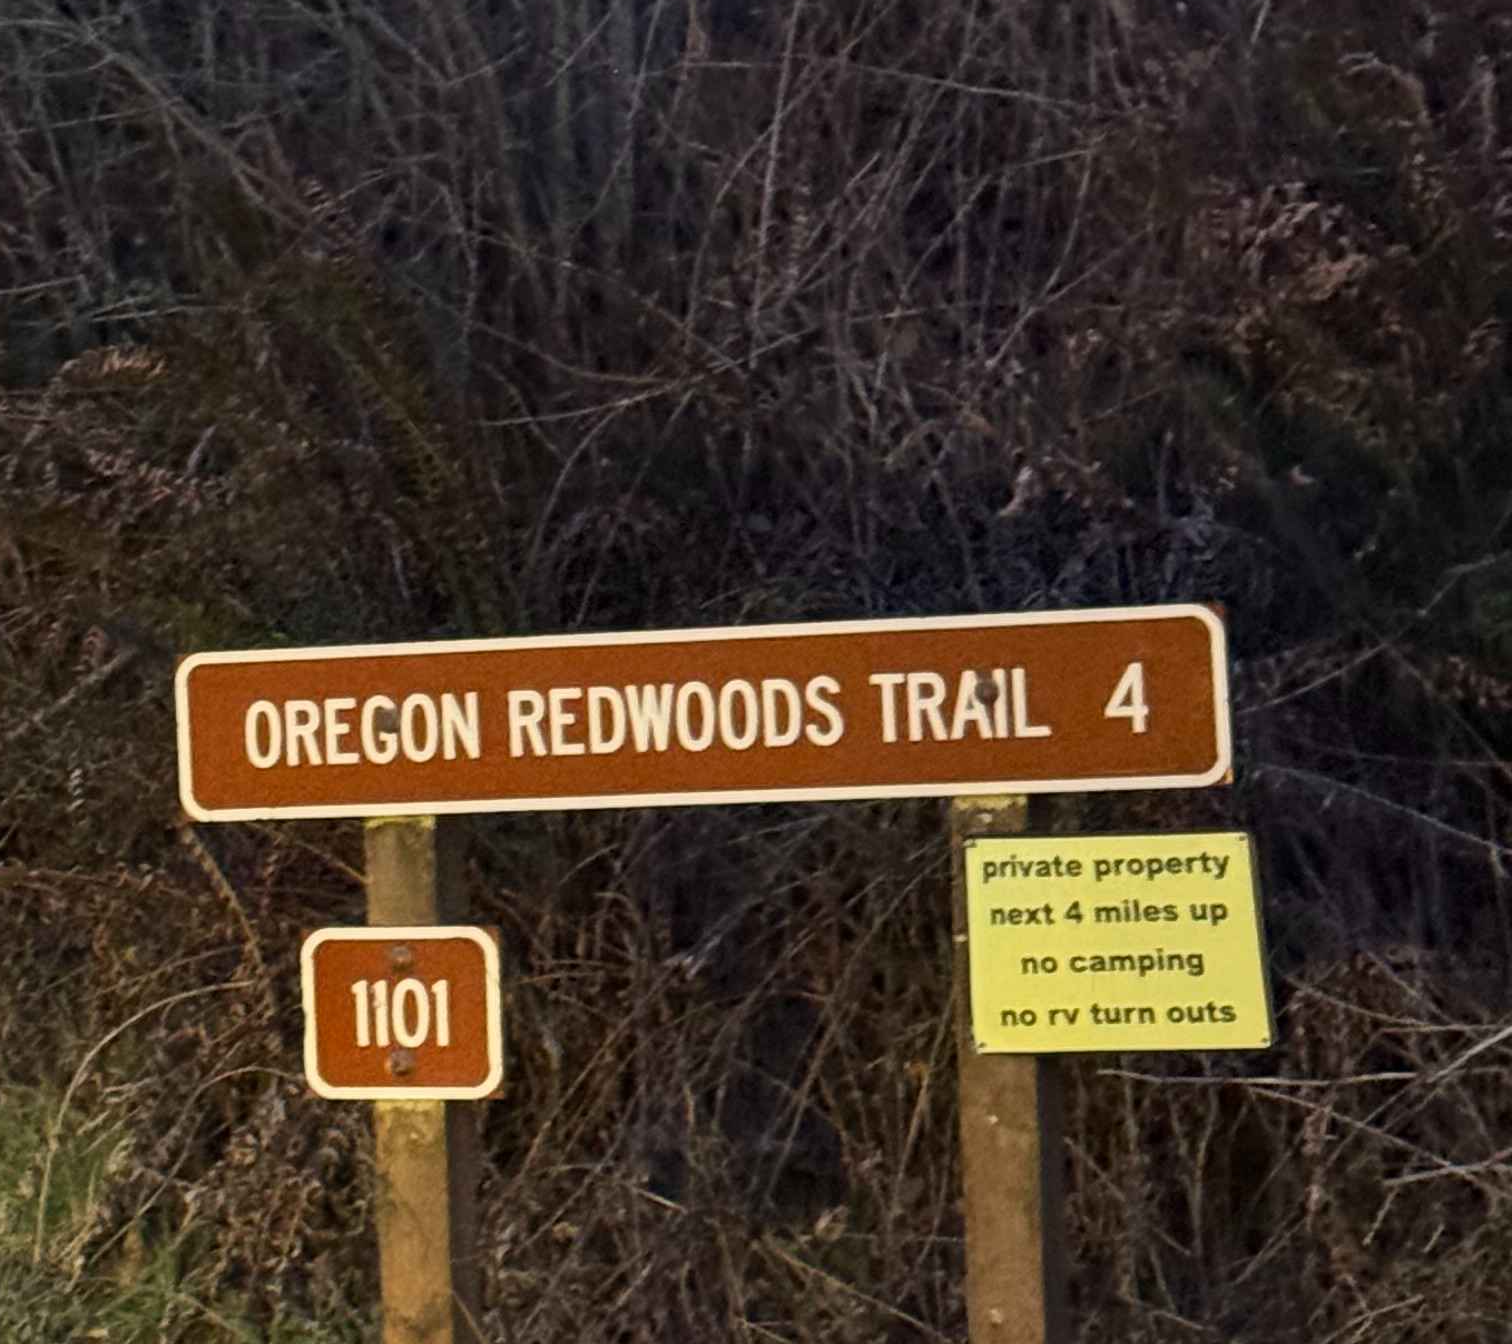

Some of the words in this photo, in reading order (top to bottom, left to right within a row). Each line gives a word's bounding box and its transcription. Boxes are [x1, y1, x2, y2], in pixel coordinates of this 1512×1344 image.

[244, 691, 480, 768] OREGON
[508, 674, 844, 757] REDWOODS
[869, 668, 1052, 743] TRAIL
[1104, 662, 1149, 734] 4
[983, 854, 1083, 884] private
[1093, 852, 1230, 881] property
[990, 903, 1055, 925] next
[1064, 901, 1083, 924] 4
[1094, 899, 1178, 923] miles
[1190, 902, 1228, 926] up
[1021, 954, 1058, 974] no
[1069, 948, 1205, 977] camping
[351, 978, 450, 1048] 1101
[1001, 1007, 1037, 1027] no
[1048, 1007, 1080, 1025] rv
[1090, 1003, 1156, 1025] turn
[1166, 1001, 1237, 1024] outs
